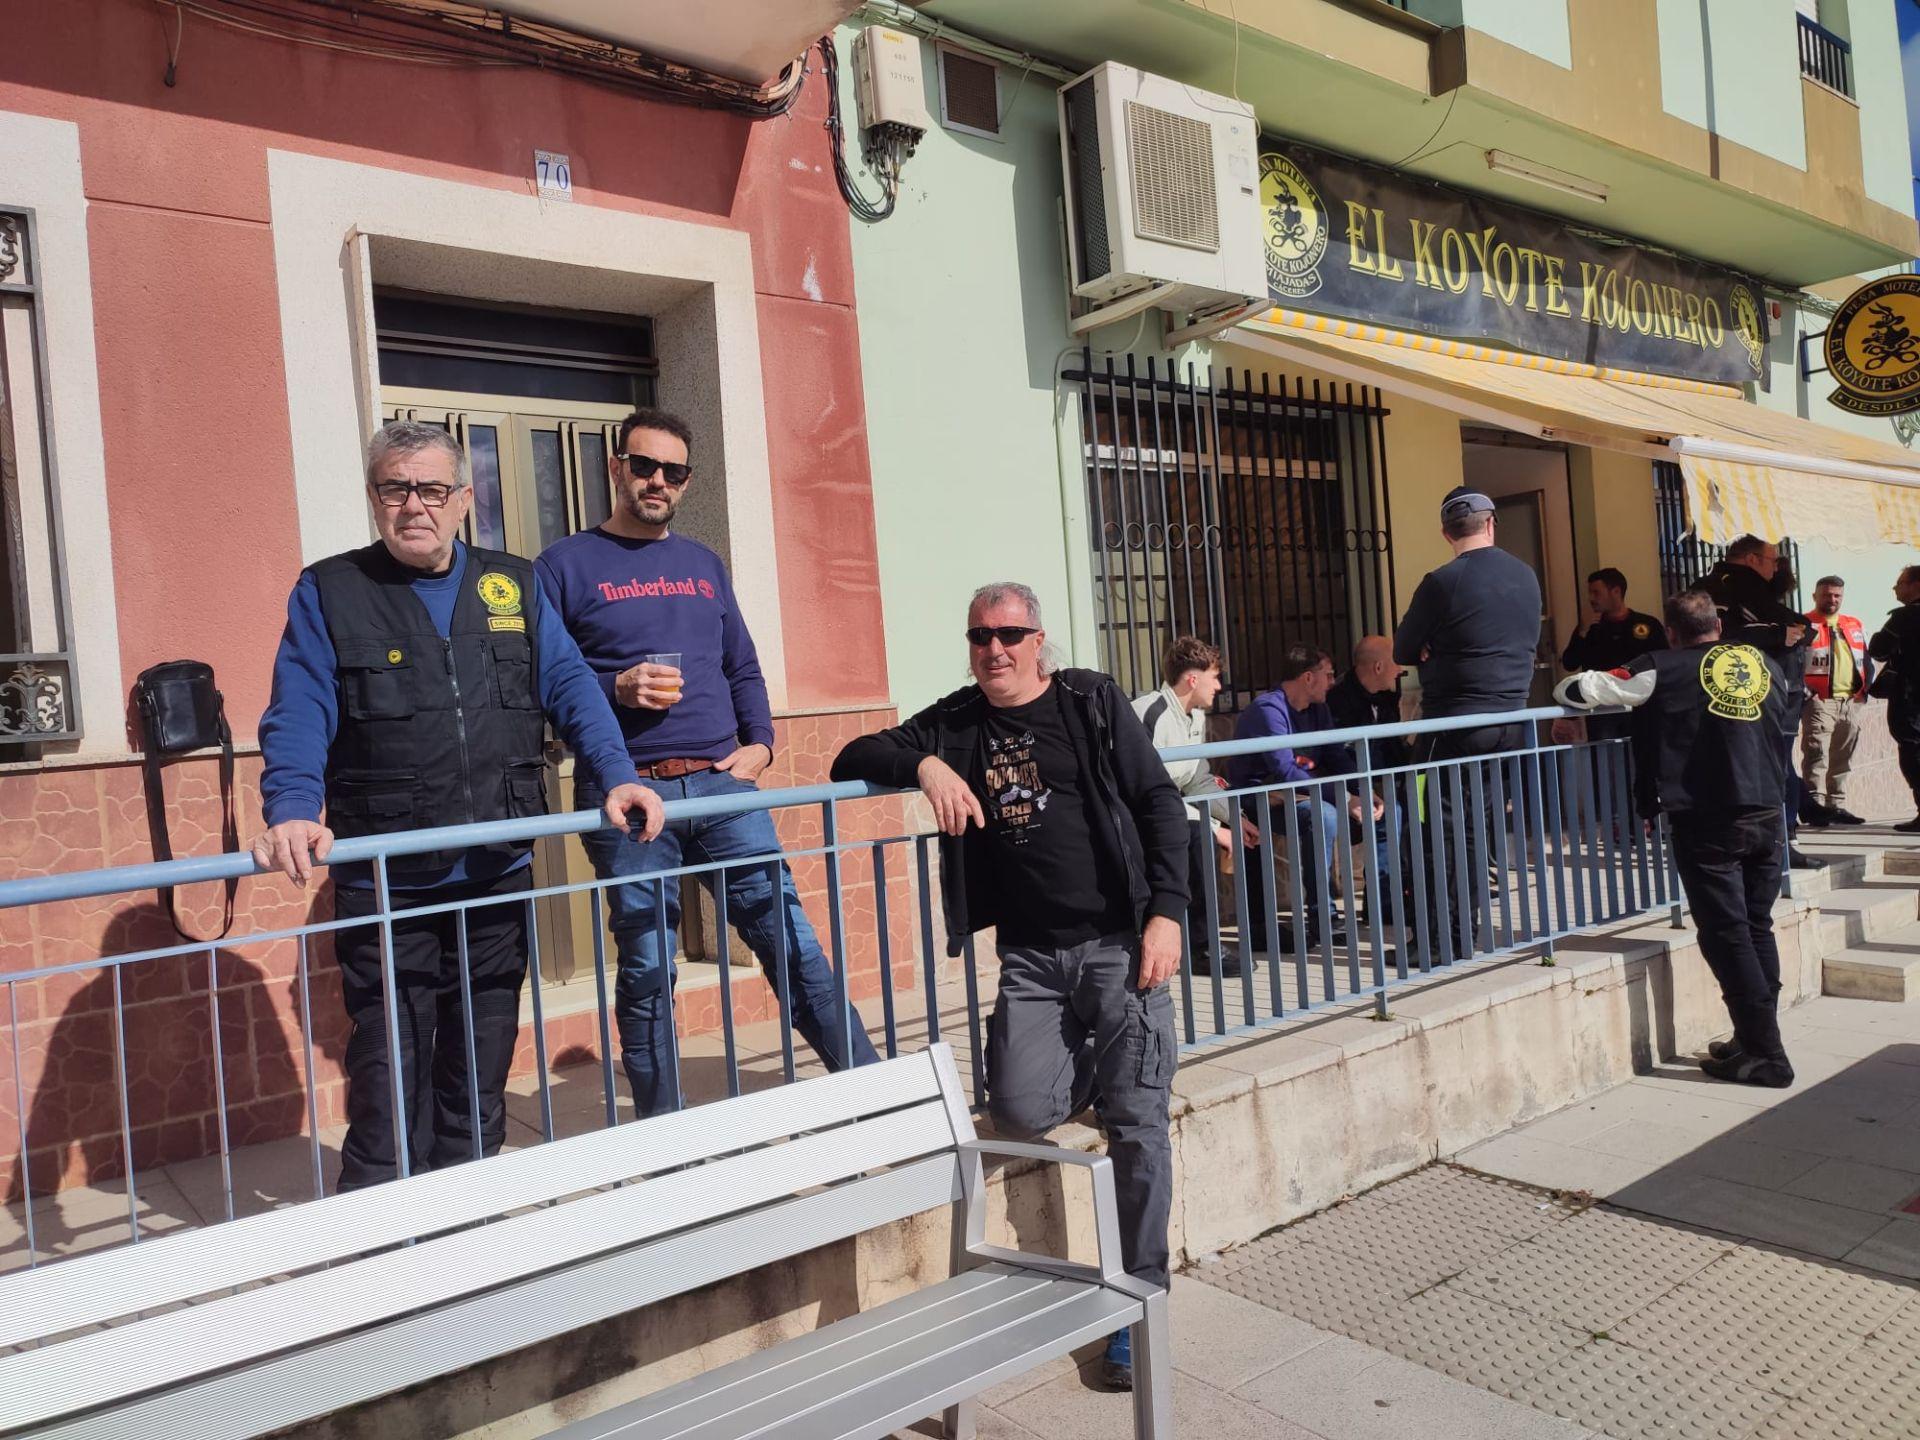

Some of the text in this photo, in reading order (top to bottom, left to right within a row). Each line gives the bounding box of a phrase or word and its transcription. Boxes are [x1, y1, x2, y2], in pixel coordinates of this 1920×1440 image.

[538, 161, 568, 190] 70
[1265, 225, 1326, 273] YOTE KOJONERO
[1265, 263, 1317, 288] MIAJADAS
[1344, 200, 1404, 282] EL
[1408, 218, 1572, 318] KOYOTE
[1579, 261, 1725, 350] KOJONERO
[1831, 338, 1844, 360] EL
[1834, 358, 1892, 391] KOYOTE
[1846, 398, 1907, 412] DESDE
[598, 576, 697, 601] Timberland
[985, 761, 1043, 797] SUMMER
[1001, 803, 1032, 818] END
